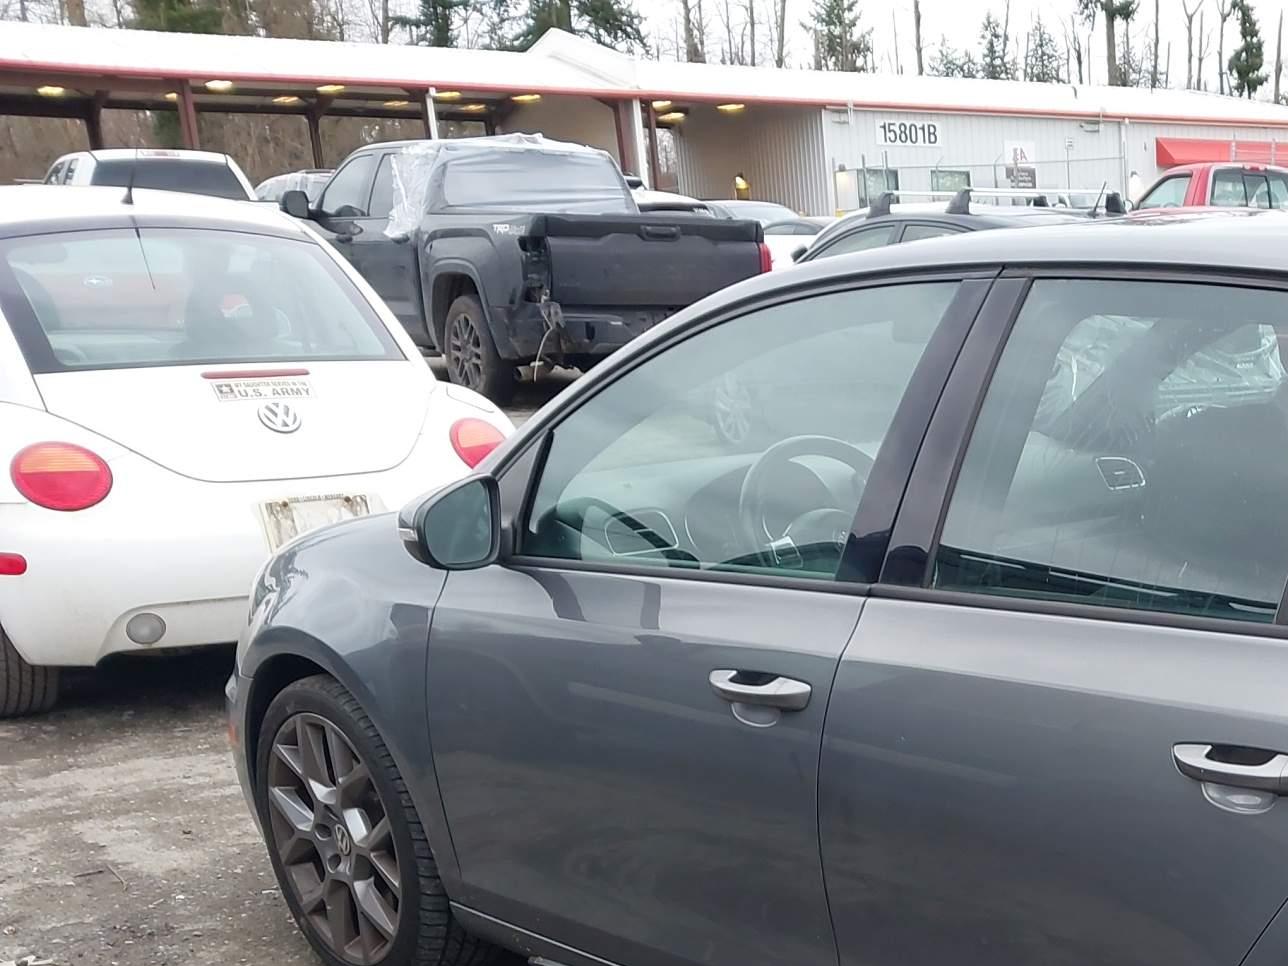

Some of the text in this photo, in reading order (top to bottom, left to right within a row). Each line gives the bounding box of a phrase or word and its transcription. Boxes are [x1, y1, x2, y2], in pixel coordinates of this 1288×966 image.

[879, 121, 938, 145] 15801B
[237, 388, 268, 398] U.S.
[271, 387, 310, 397] ARMY
